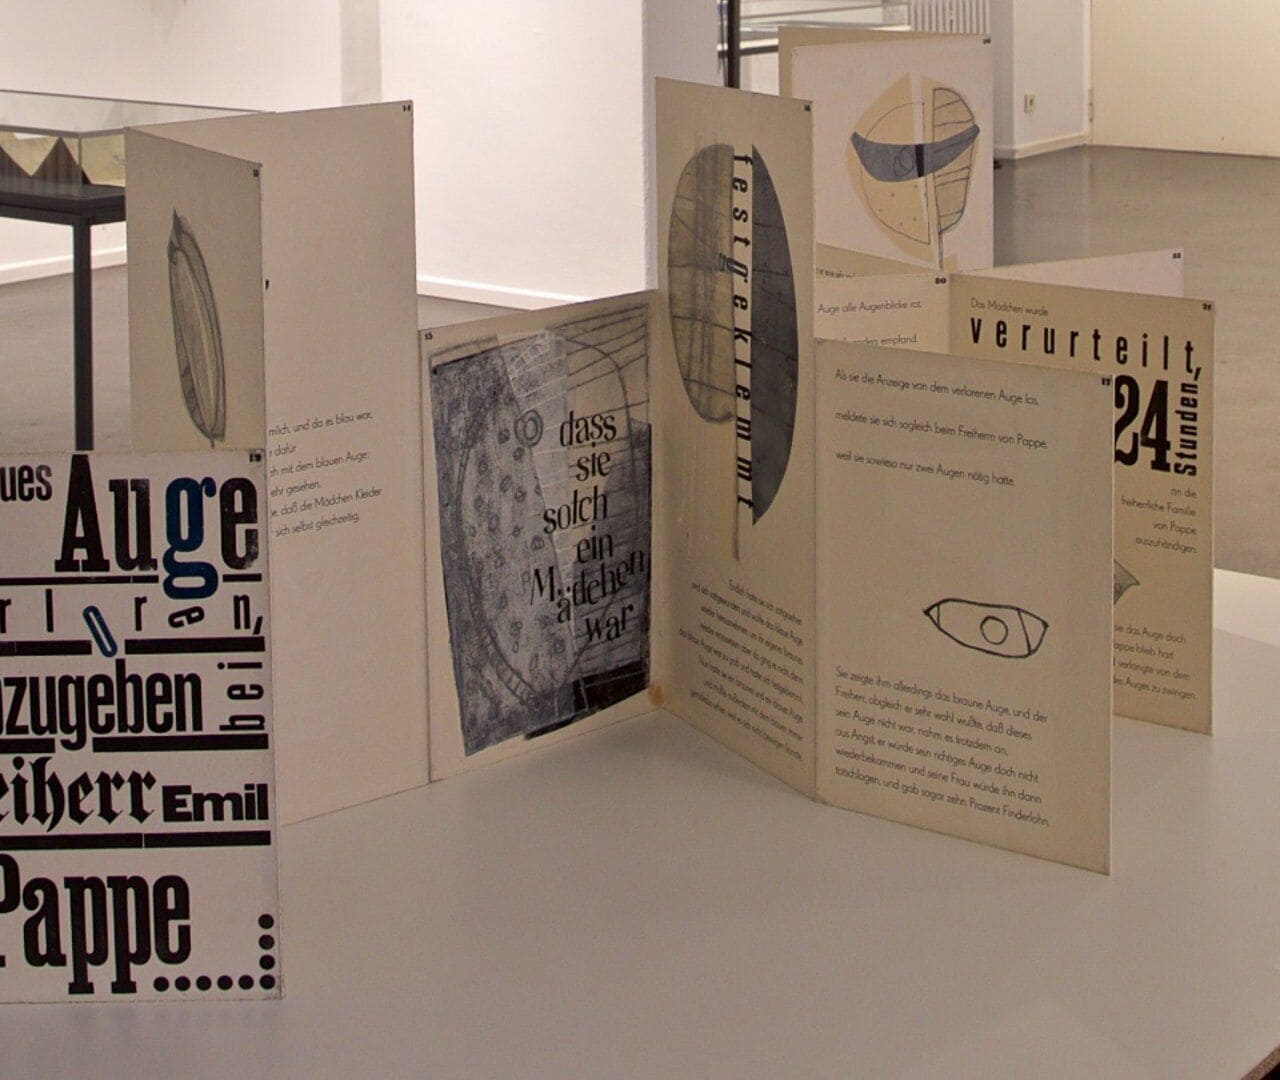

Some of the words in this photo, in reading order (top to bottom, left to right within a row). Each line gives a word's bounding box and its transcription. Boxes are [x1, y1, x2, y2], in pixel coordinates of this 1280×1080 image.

[818, 301, 839, 316] Auge
[842, 302, 856, 312] alle
[859, 300, 908, 313] Augenblicke
[971, 298, 986, 309] Das
[1025, 304, 1049, 317] wurde
[720, 151, 754, 512] festgeklemmt
[835, 369, 847, 380] Als
[849, 373, 859, 382] sie
[861, 373, 874, 383] die
[876, 374, 910, 390] Anzeige
[912, 382, 927, 391] von
[930, 380, 949, 394] dem
[952, 385, 996, 399] verlorenen
[998, 389, 1023, 405] Auge
[293, 418, 310, 432] und
[312, 416, 323, 428] da
[336, 413, 353, 424] blau
[559, 409, 617, 448] dass
[835, 410, 867, 423] meldete
[870, 416, 880, 425] sie
[883, 416, 897, 428] sich
[900, 417, 932, 432] sogleich
[935, 420, 956, 436] beim
[998, 435, 1014, 444] von
[1115, 375, 1171, 472] 24
[281, 464, 294, 475] mit
[296, 460, 313, 472] dem
[315, 456, 343, 468] blauen
[575, 442, 611, 482] sie
[836, 450, 851, 461] weil
[854, 454, 864, 462] sie
[867, 457, 897, 468] sowieso
[900, 462, 913, 470] nur
[916, 464, 934, 473] zwei
[937, 464, 964, 480] Augen
[300, 500, 312, 511] die
[356, 486, 382, 500] Kleider
[542, 486, 608, 535] solch
[1171, 488, 1181, 496] an
[1184, 487, 1197, 498] die
[55, 454, 260, 600] Auge
[292, 520, 313, 533] selbst
[575, 524, 614, 563] ein
[1153, 522, 1167, 530] von
[1170, 521, 1197, 535] Pappe
[529, 547, 644, 624] Mädchen
[584, 601, 634, 644] war
[1127, 624, 1140, 635] das
[1143, 628, 1163, 641] Auge
[1114, 641, 1134, 653] appe
[1125, 677, 1150, 692] Auges
[1152, 684, 1161, 693] zu
[1156, 668, 1171, 676] von
[1173, 670, 1191, 680] dem
[217, 661, 267, 733] bei
[836, 665, 848, 678] Sie
[850, 673, 874, 686] zeigte
[877, 675, 891, 687] ihm
[893, 680, 932, 699] allerdings
[935, 687, 950, 702] das
[952, 695, 984, 709] braune
[1013, 708, 1030, 719] und
[1033, 711, 1048, 722] der
[836, 709, 851, 718] sein
[853, 710, 875, 726] Auge
[877, 718, 896, 728] nicht
[918, 726, 943, 740] nahm
[945, 734, 953, 742] es
[956, 735, 992, 751] trotzdem
[869, 695, 902, 709] obgleich
[916, 706, 931, 716] sehr
[934, 711, 954, 723] wohl
[986, 722, 1004, 734] daß
[1006, 726, 1032, 740] dieses
[836, 728, 849, 738] aus
[916, 749, 931, 758] sein
[934, 749, 966, 768] richtiges
[969, 757, 992, 773] Auge
[995, 764, 1015, 776] doch
[1018, 770, 1038, 783] nicht
[836, 747, 906, 770] wiederbekommen
[909, 766, 925, 776] und
[927, 768, 948, 782] seine
[951, 771, 971, 787] Frau
[1002, 786, 1016, 798] ihn
[1018, 790, 1041, 804] dann
[161, 783, 270, 823] Emil
[883, 779, 899, 789] und
[902, 781, 919, 795] gab
[921, 787, 944, 802] sogar
[947, 793, 967, 806] zehn
[970, 797, 1001, 815] Prozent
